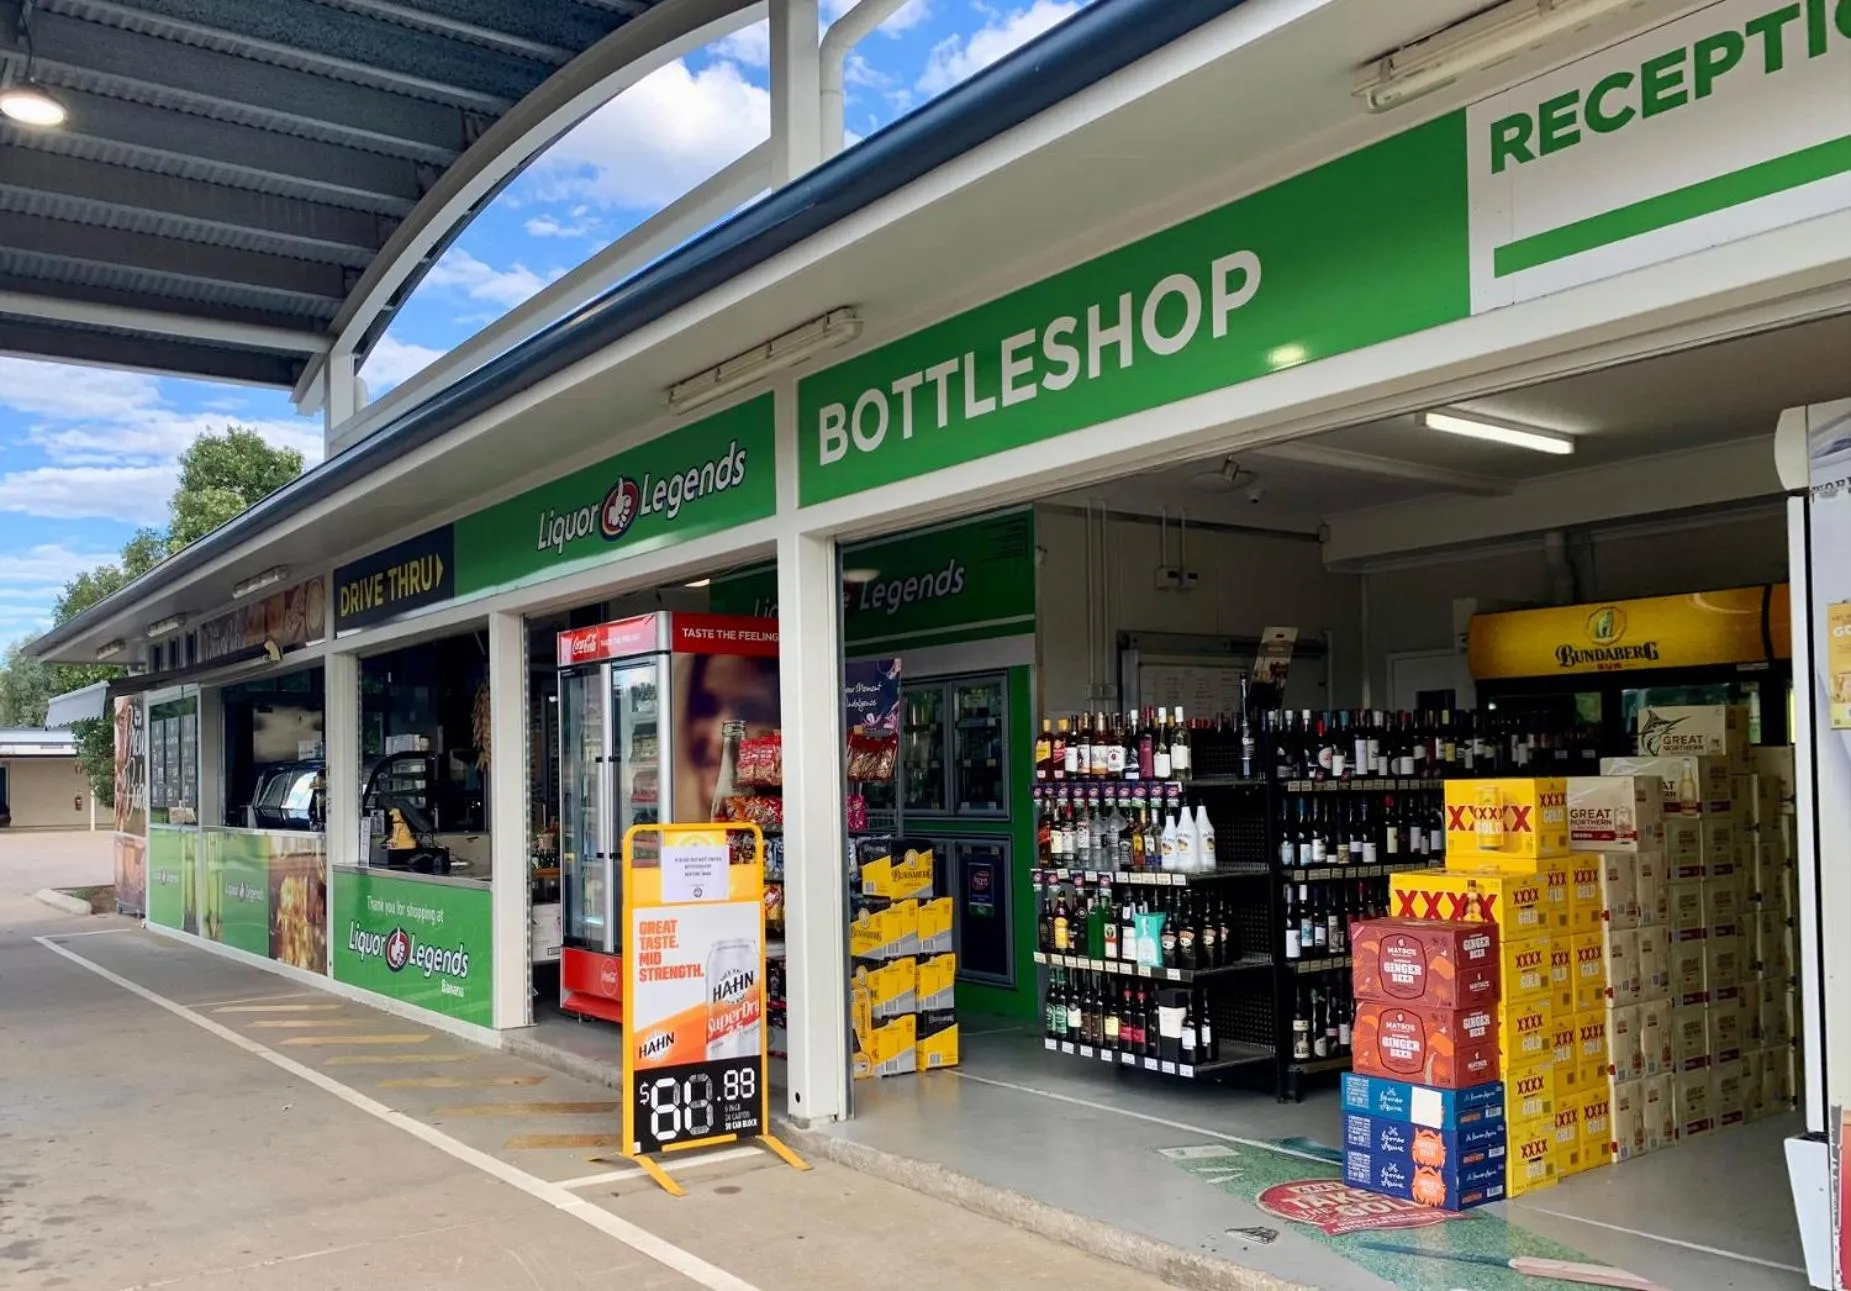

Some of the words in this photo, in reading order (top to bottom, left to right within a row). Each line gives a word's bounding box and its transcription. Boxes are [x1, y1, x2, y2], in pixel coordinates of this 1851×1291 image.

[819, 250, 1262, 466] BOTTLESHOP
[537, 509, 599, 554] Liquor
[639, 439, 747, 519] Legends
[340, 574, 384, 617] DRIVE
[386, 555, 435, 600] THRU
[860, 558, 965, 615] Legends
[682, 628, 714, 639] TASTE
[718, 629, 736, 640] THE
[739, 631, 779, 641] FEELING
[1554, 641, 1660, 667] BUNDABERG
[1663, 735, 1703, 745] GREAT
[1540, 792, 1567, 808] XXXX
[1570, 808, 1612, 819] GREAT
[1574, 869, 1599, 884] XXXX
[1513, 888, 1539, 905] XXXX
[367, 895, 384, 913] Thank
[385, 902, 396, 916] you
[397, 902, 405, 914] for
[407, 903, 435, 925] shopping
[437, 909, 444, 923] at
[639, 919, 678, 935] GREAT
[348, 920, 385, 960] Liquor
[409, 933, 470, 978] Legends
[639, 935, 679, 951] TASTE.
[1463, 936, 1490, 951] GINGER
[639, 952, 662, 966] MID
[1515, 951, 1542, 969] XXXX
[1577, 946, 1603, 962] XXXX
[639, 964, 704, 982] STRENGTH.
[1384, 962, 1422, 976] GINGER
[713, 970, 754, 1004] HAHN
[1463, 1014, 1491, 1030] GINGER
[1517, 1014, 1543, 1032] XXXX
[1580, 1023, 1606, 1041] XXXX
[638, 1032, 675, 1059] HAHN
[1382, 1036, 1420, 1051] GINGER
[1517, 1076, 1545, 1095] XXXX
[1584, 1101, 1610, 1120] XXXX
[732, 1120, 742, 1130] CAN
[743, 1118, 758, 1128] BLOCK
[1520, 1138, 1548, 1159] XXXX
[1281, 1189, 1373, 1209] TAKE
[1335, 1199, 1426, 1217] GOL
